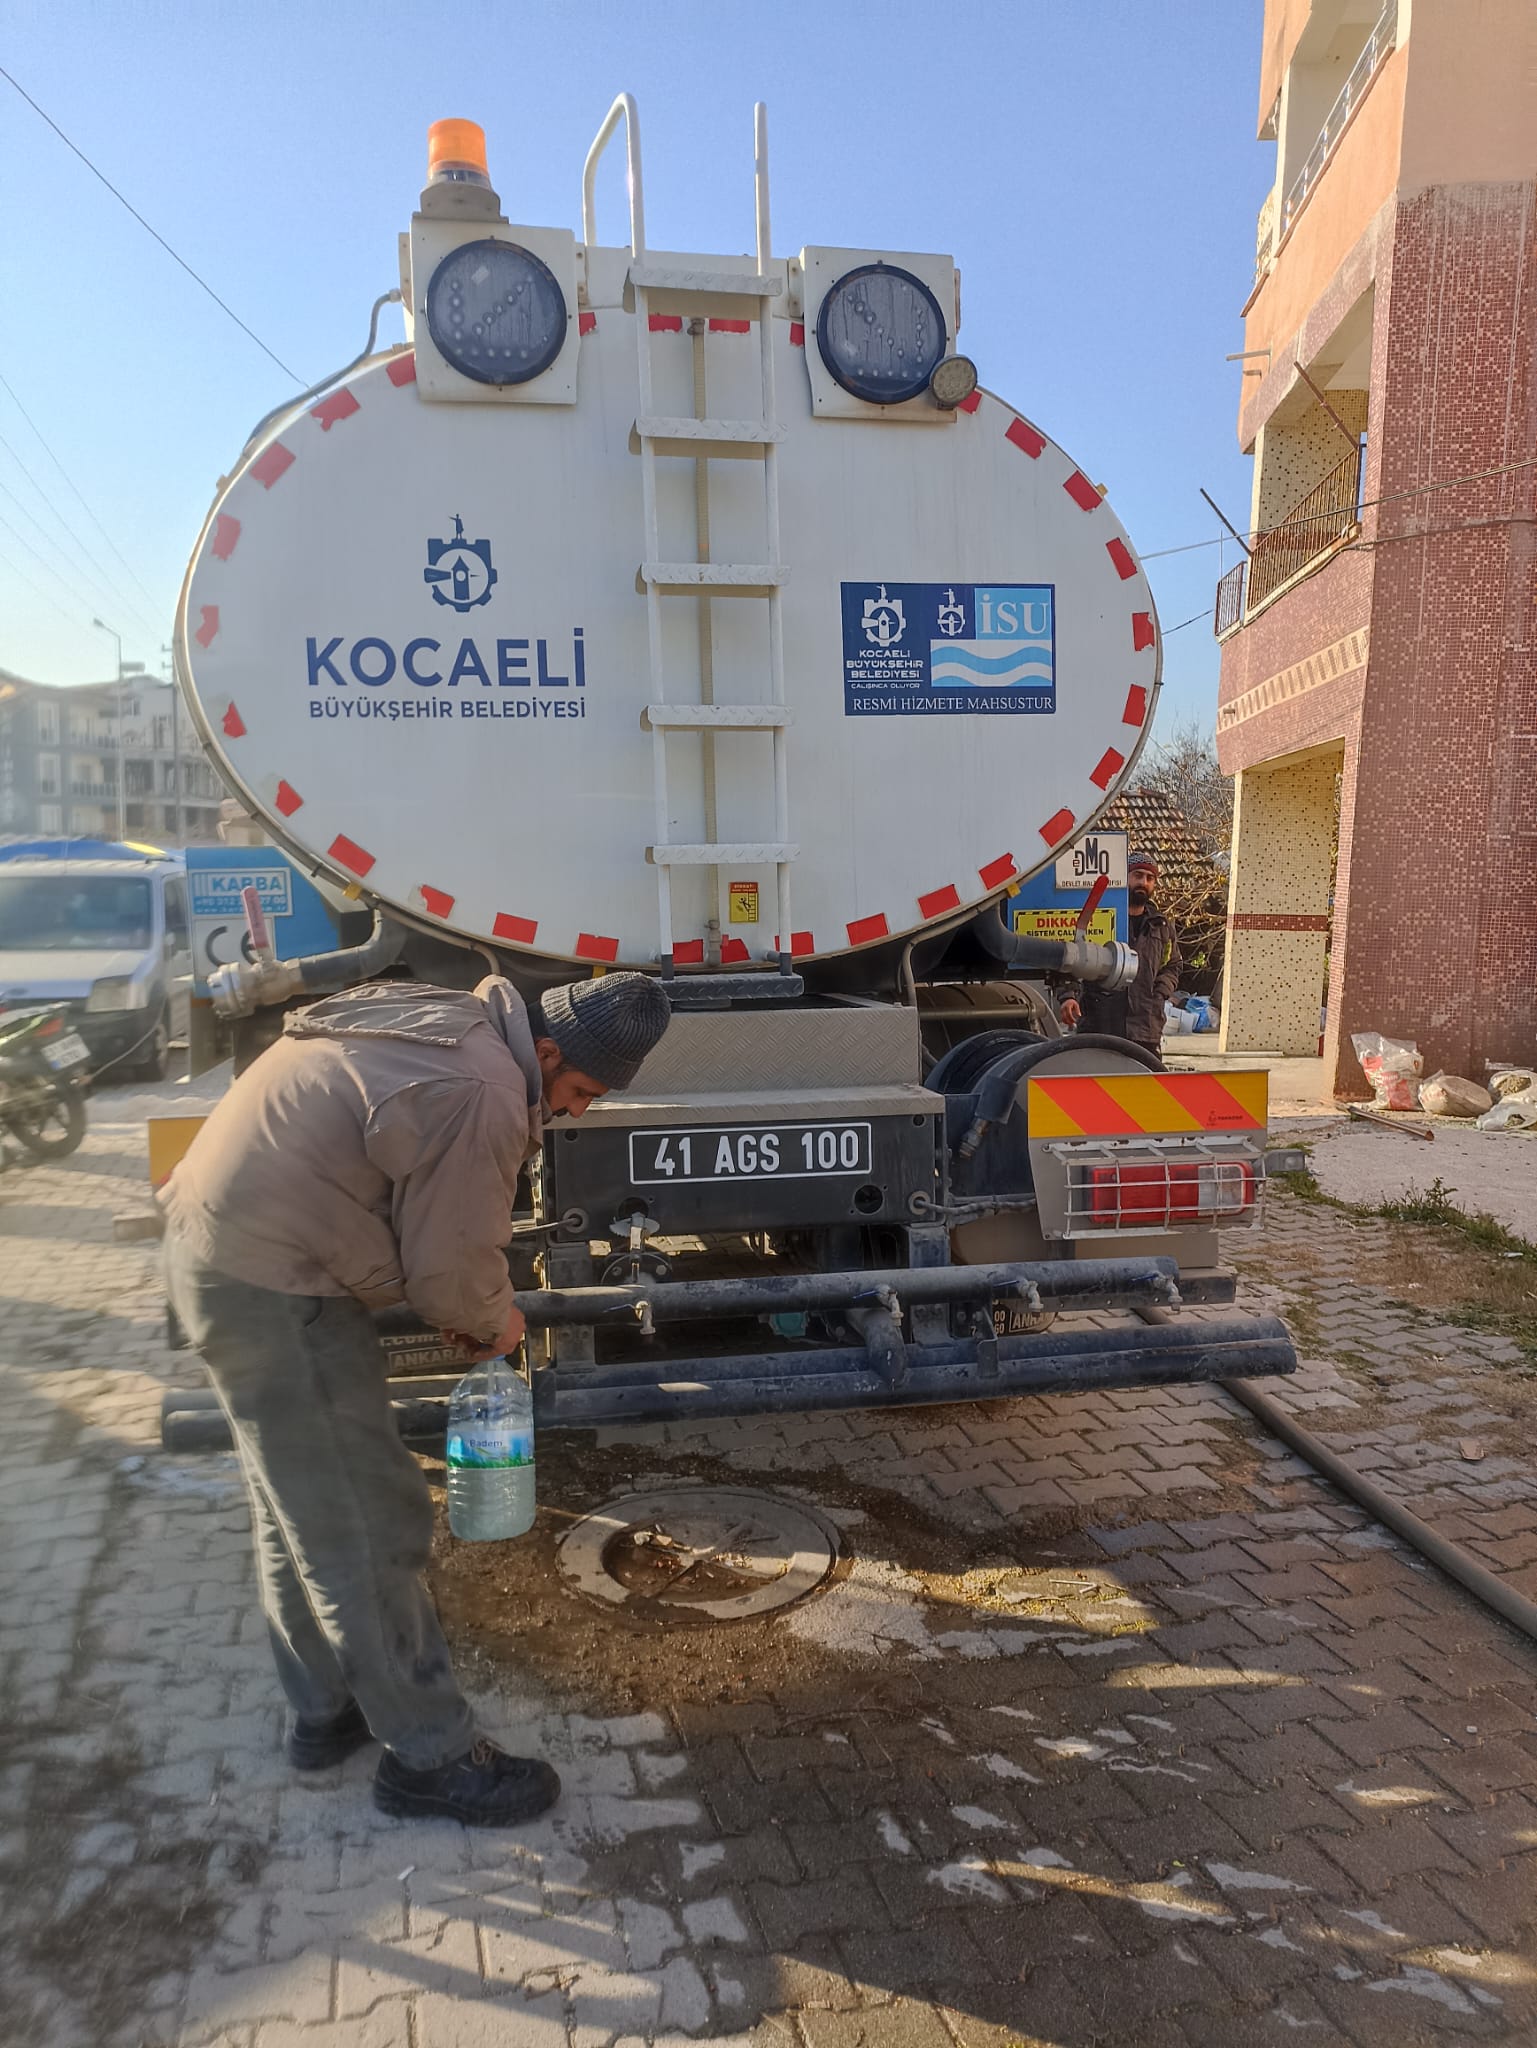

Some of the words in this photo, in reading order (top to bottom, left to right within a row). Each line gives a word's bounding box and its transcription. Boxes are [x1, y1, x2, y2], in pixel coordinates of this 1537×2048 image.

[979, 593, 1050, 635] İSU
[305, 627, 587, 687] KOCAELİ
[859, 649, 911, 659] KOCAELİ
[846, 659, 924, 670] BÜYÜKŞEHİR
[850, 669, 920, 679] BELEDİYESİ
[309, 696, 453, 721] BÜYÜKŞEHİR
[460, 696, 586, 719] BELEDİYESİ
[853, 695, 897, 711] RESMİ
[901, 695, 964, 710] HİZMETE
[967, 696, 1054, 710] MAHSUSTUR
[653, 1136, 692, 1177] 41
[713, 1133, 781, 1175] AGS
[801, 1129, 860, 1171] 100
